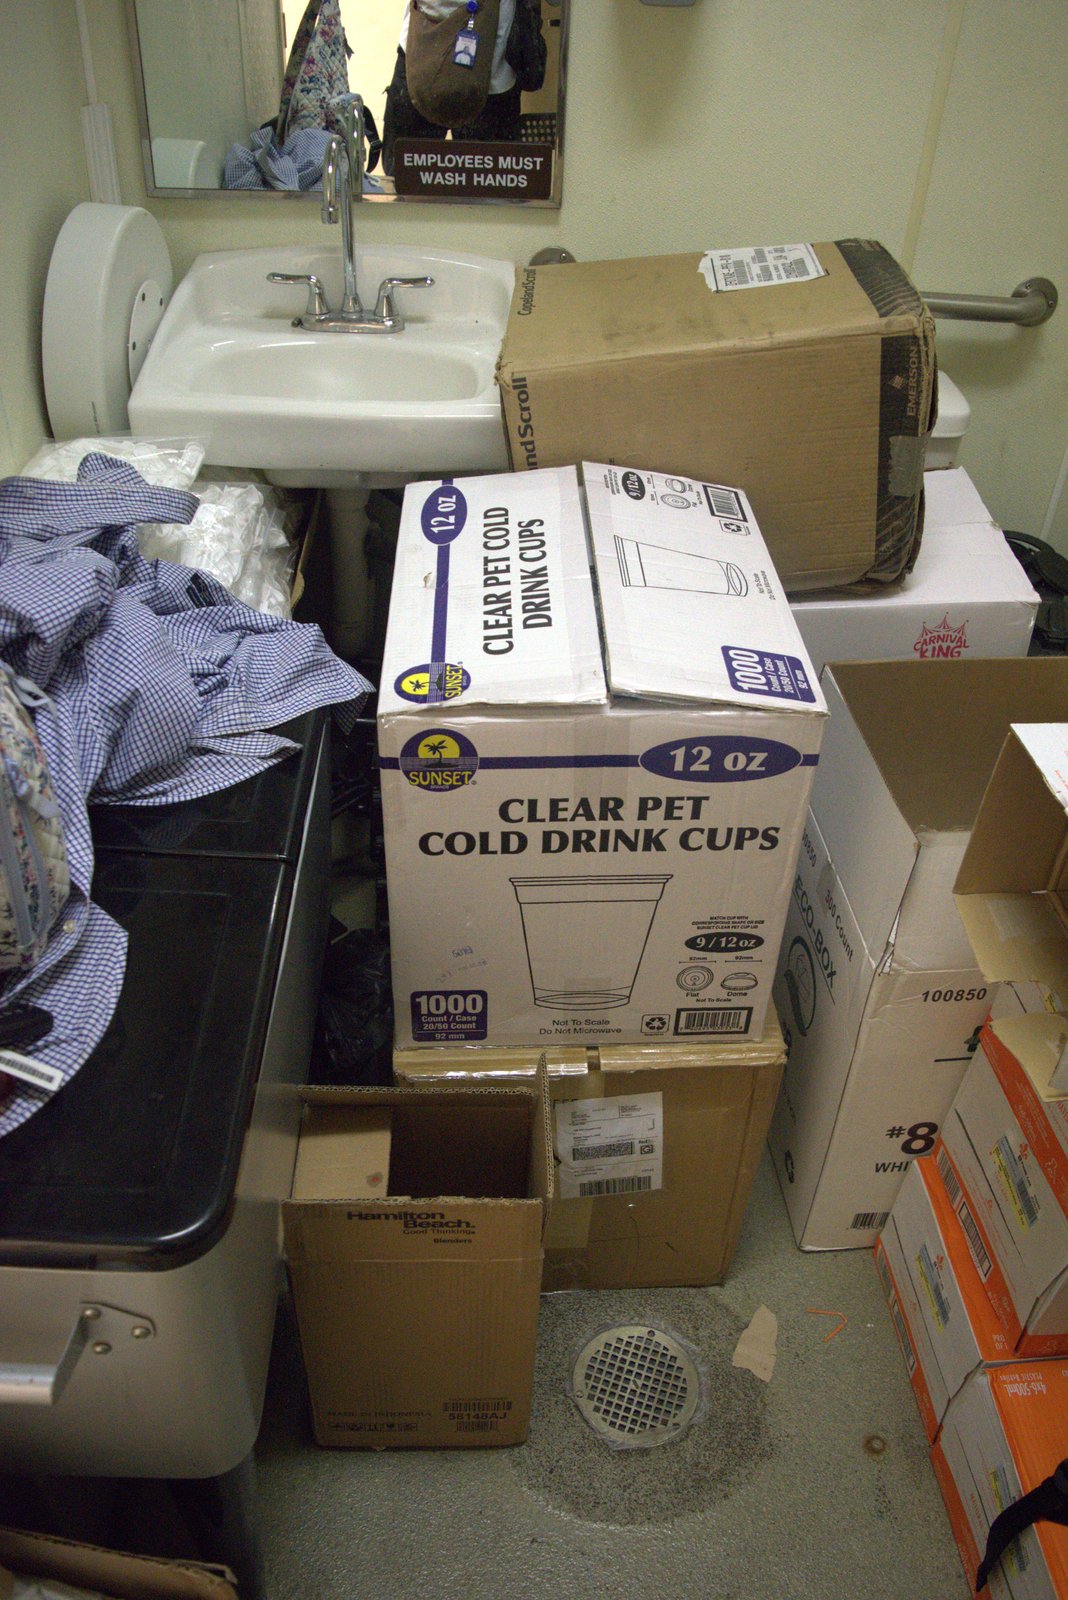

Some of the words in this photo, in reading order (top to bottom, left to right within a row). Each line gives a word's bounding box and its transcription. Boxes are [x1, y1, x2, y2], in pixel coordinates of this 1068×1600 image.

[404, 153, 493, 169] EMPLOYEES
[498, 155, 544, 171] MUST
[419, 172, 466, 185] WASH
[473, 174, 528, 188] HANDS
[906, 346, 919, 416] EMERSON
[521, 440, 538, 470] nd
[438, 495, 456, 511] oz
[430, 515, 456, 533] 12
[483, 506, 510, 551] COLD
[518, 518, 547, 562] CUPS
[483, 556, 511, 587] PET
[520, 565, 552, 629] DRINK
[482, 591, 514, 655] CLEAR
[913, 634, 969, 652] CARNIVAL
[919, 645, 961, 658] KING
[728, 649, 769, 691] 1000
[764, 657, 774, 671] Case
[774, 659, 788, 676] Count
[445, 665, 463, 698] SUNSET
[768, 675, 781, 692] Count
[669, 746, 712, 772] 12
[723, 752, 768, 772] oz
[409, 771, 472, 785] SUNSET
[499, 797, 624, 823] CLEAR
[637, 796, 710, 821] PET
[418, 831, 528, 856] COLD
[541, 828, 669, 854] DRINK
[679, 827, 781, 851] CUPS
[795, 875, 837, 988] ECO-BOX
[825, 889, 837, 918] 300
[835, 916, 853, 962] Count
[416, 994, 483, 1014] 1000
[921, 987, 988, 1002] 100850
[584, 1018, 610, 1026] Scale
[885, 1122, 938, 1154] #8
[874, 1160, 912, 1173] WHI
[347, 1211, 445, 1220] Hamilton
